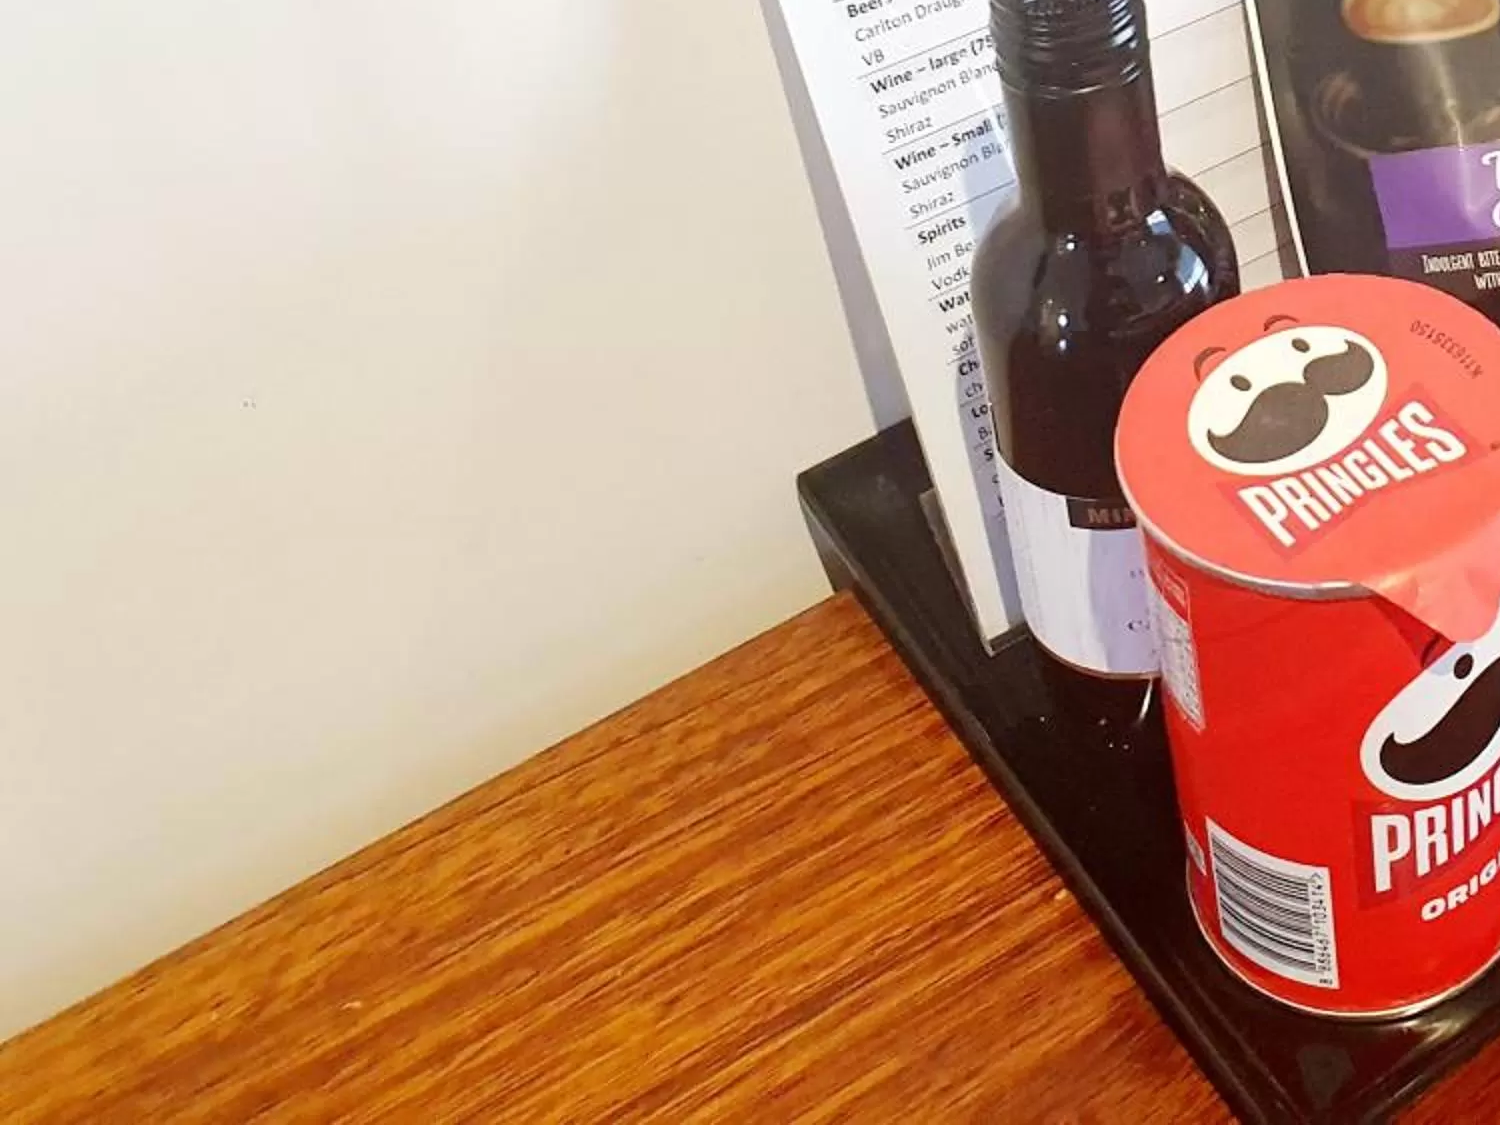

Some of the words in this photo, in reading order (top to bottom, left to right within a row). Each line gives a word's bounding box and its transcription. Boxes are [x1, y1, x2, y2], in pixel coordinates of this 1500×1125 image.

[859, 47, 885, 67] VB
[868, 69, 913, 95] Wine
[926, 46, 969, 72] large
[876, 77, 957, 120] Sauvignon
[883, 115, 934, 144] Shiraz
[891, 145, 937, 171] Wine
[950, 117, 993, 146] Small
[900, 151, 980, 195] Sauvignon
[907, 190, 956, 220] Shiraz
[915, 214, 967, 246] Spirits
[925, 250, 952, 272] Jim
[930, 266, 971, 290] Vodk
[1236, 400, 1468, 548] PRINGLES
